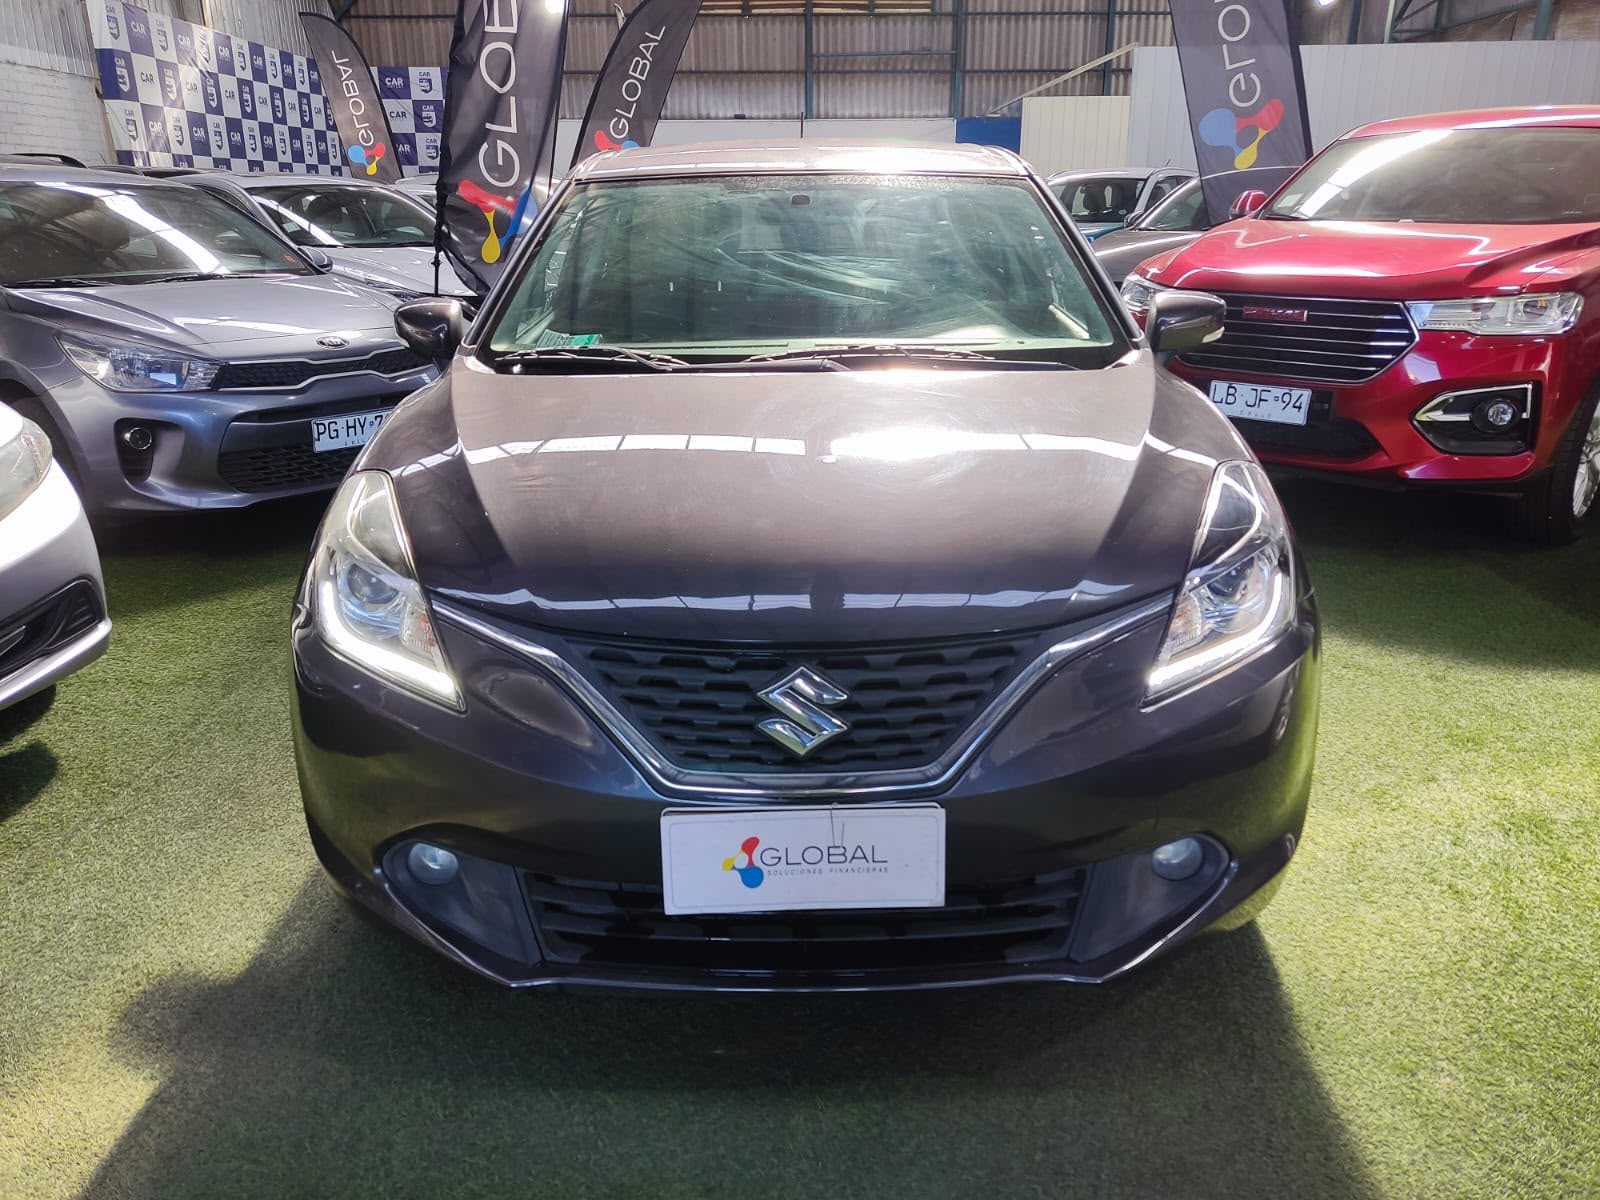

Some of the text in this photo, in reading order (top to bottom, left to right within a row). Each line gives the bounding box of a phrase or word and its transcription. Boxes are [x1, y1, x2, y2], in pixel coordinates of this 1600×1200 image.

[130, 21, 147, 35] CAR
[140, 72, 154, 84] CAR
[386, 77, 404, 86] CAR
[609, 26, 666, 139] GLOBAL
[186, 82, 198, 93] CAR
[389, 111, 407, 119] CAR
[149, 121, 163, 133] CAR
[193, 127, 205, 139] CAR
[230, 131, 241, 142] CAR
[760, 844, 889, 867] GLOBAL
[767, 866, 889, 877] SOLUCIONES FINANCIERAS
